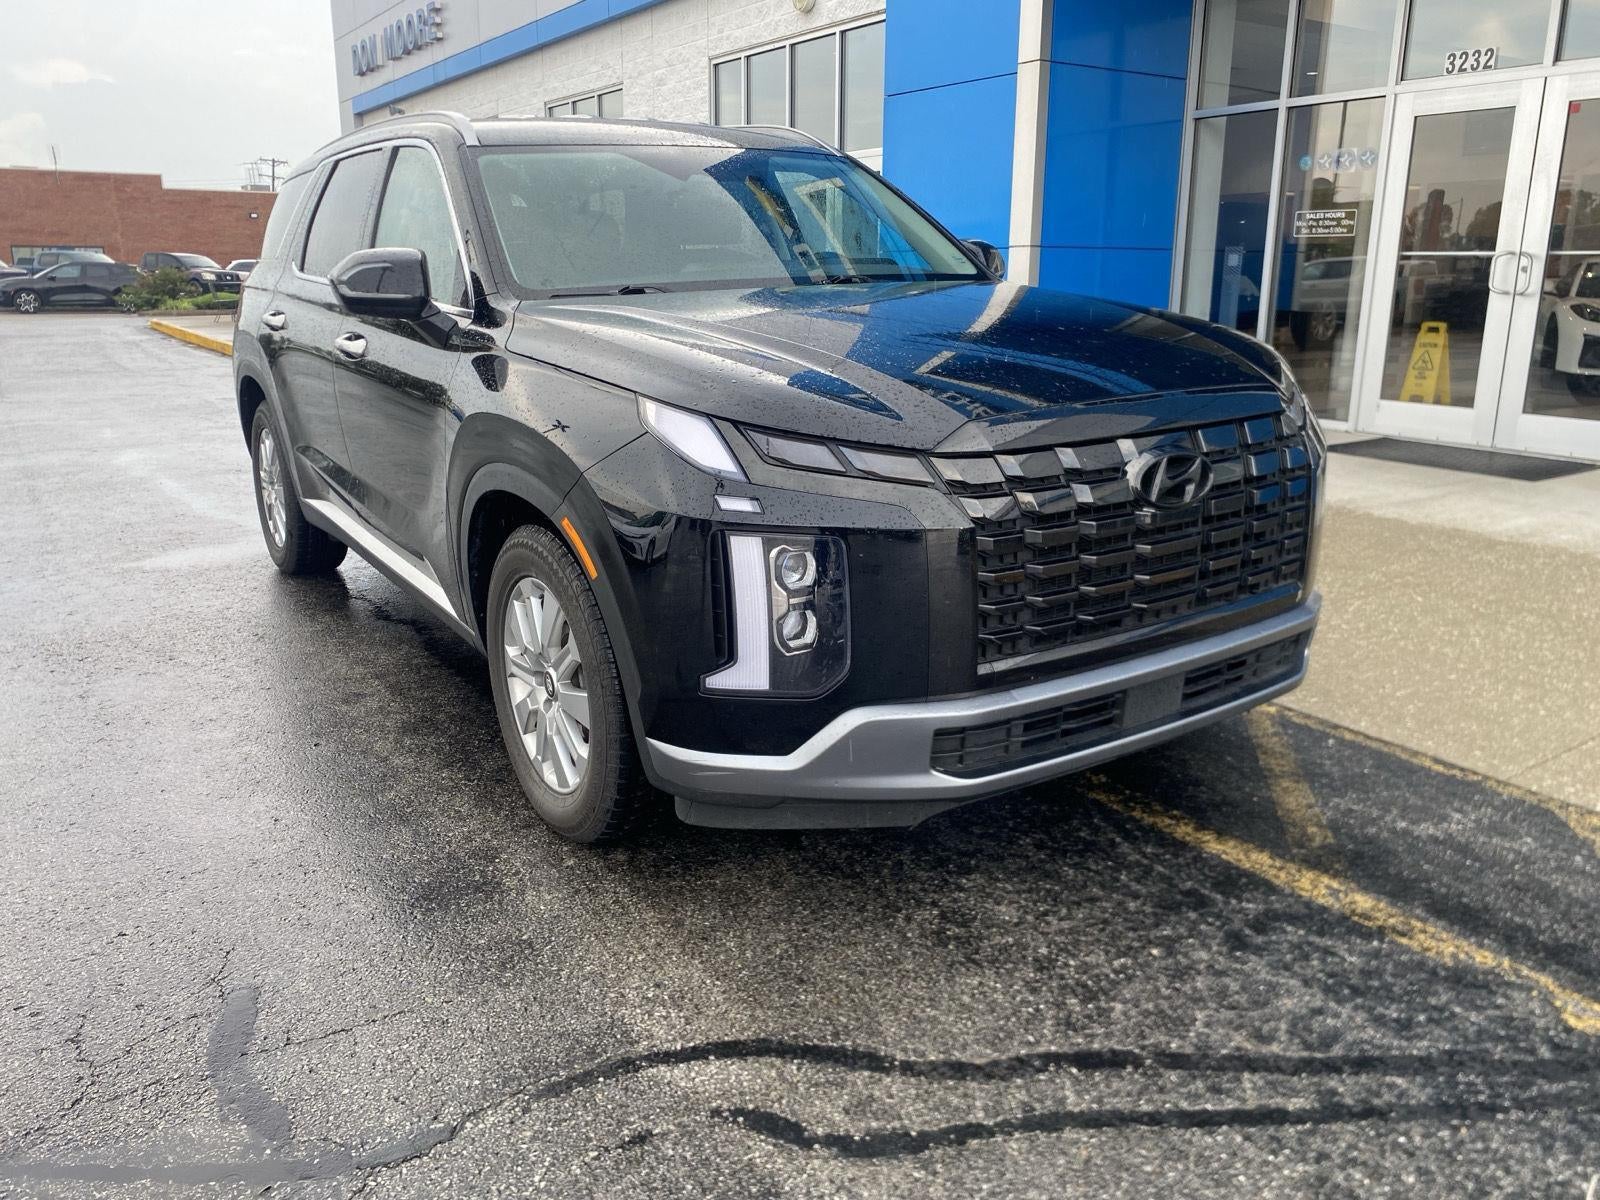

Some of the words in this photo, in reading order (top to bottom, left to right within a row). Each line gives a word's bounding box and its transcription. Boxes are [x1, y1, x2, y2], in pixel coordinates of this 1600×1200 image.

[351, 34, 381, 76] DON
[383, 1, 443, 61] MOORE
[1445, 47, 1495, 75] 3232
